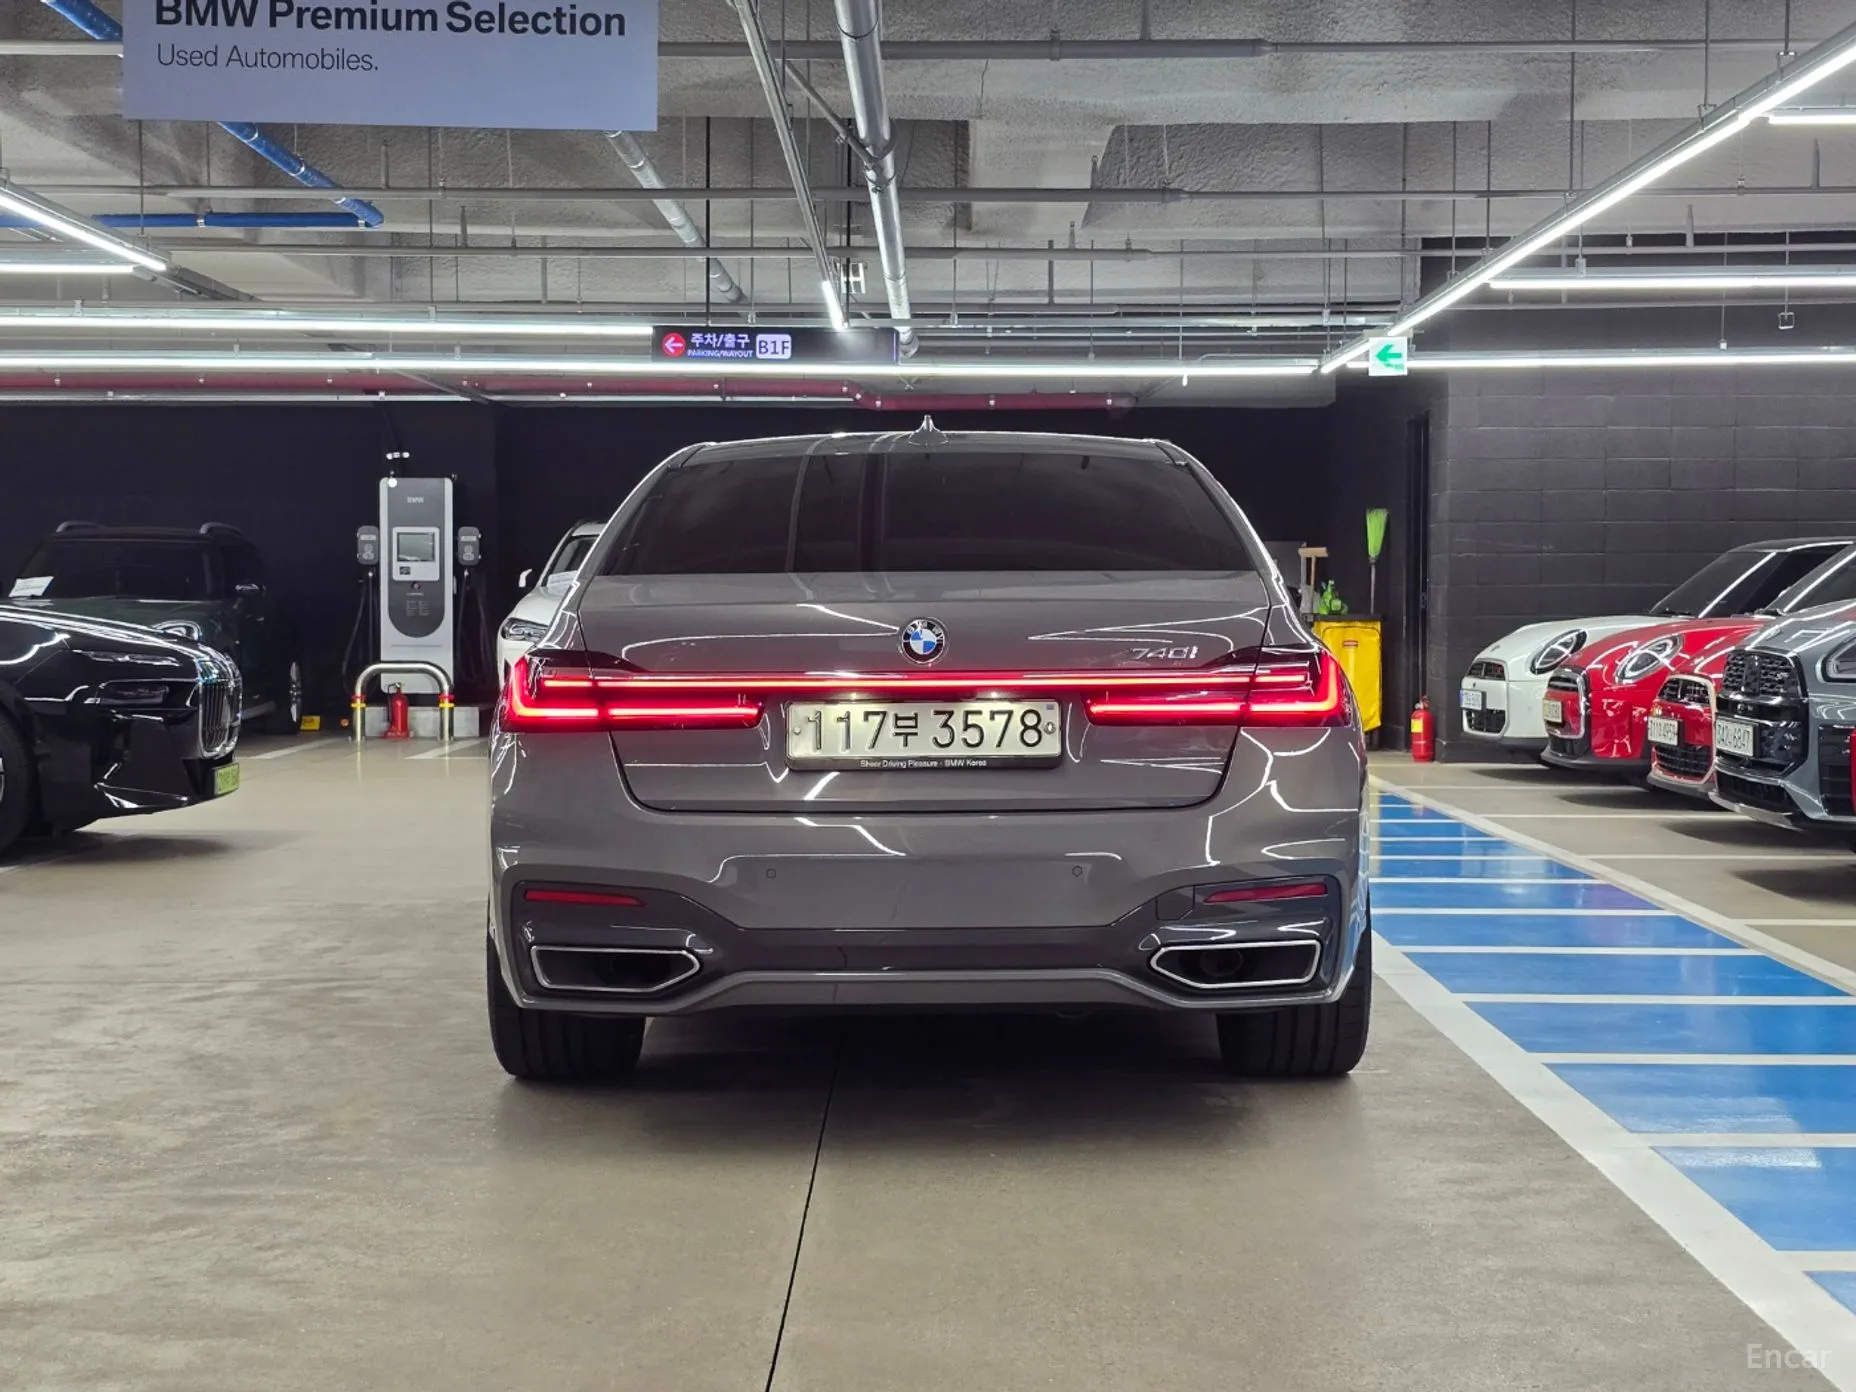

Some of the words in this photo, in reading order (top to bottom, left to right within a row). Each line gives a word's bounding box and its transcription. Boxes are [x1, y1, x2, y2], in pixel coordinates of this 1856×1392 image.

[155, 0, 259, 28] BMW
[269, 0, 438, 32] Premium
[446, 0, 626, 36] Selection
[157, 43, 218, 67] Used
[225, 45, 379, 71] Automobiles.
[691, 333, 751, 348] 주차/출구
[758, 340, 790, 355] B1F
[807, 709, 919, 751] 117부
[931, 709, 1043, 749] 3578
[860, 760, 881, 768] Sheer
[883, 760, 906, 768] Driving
[908, 760, 938, 769] Pleasure
[944, 760, 964, 768] BMW
[966, 759, 987, 767] Korea
